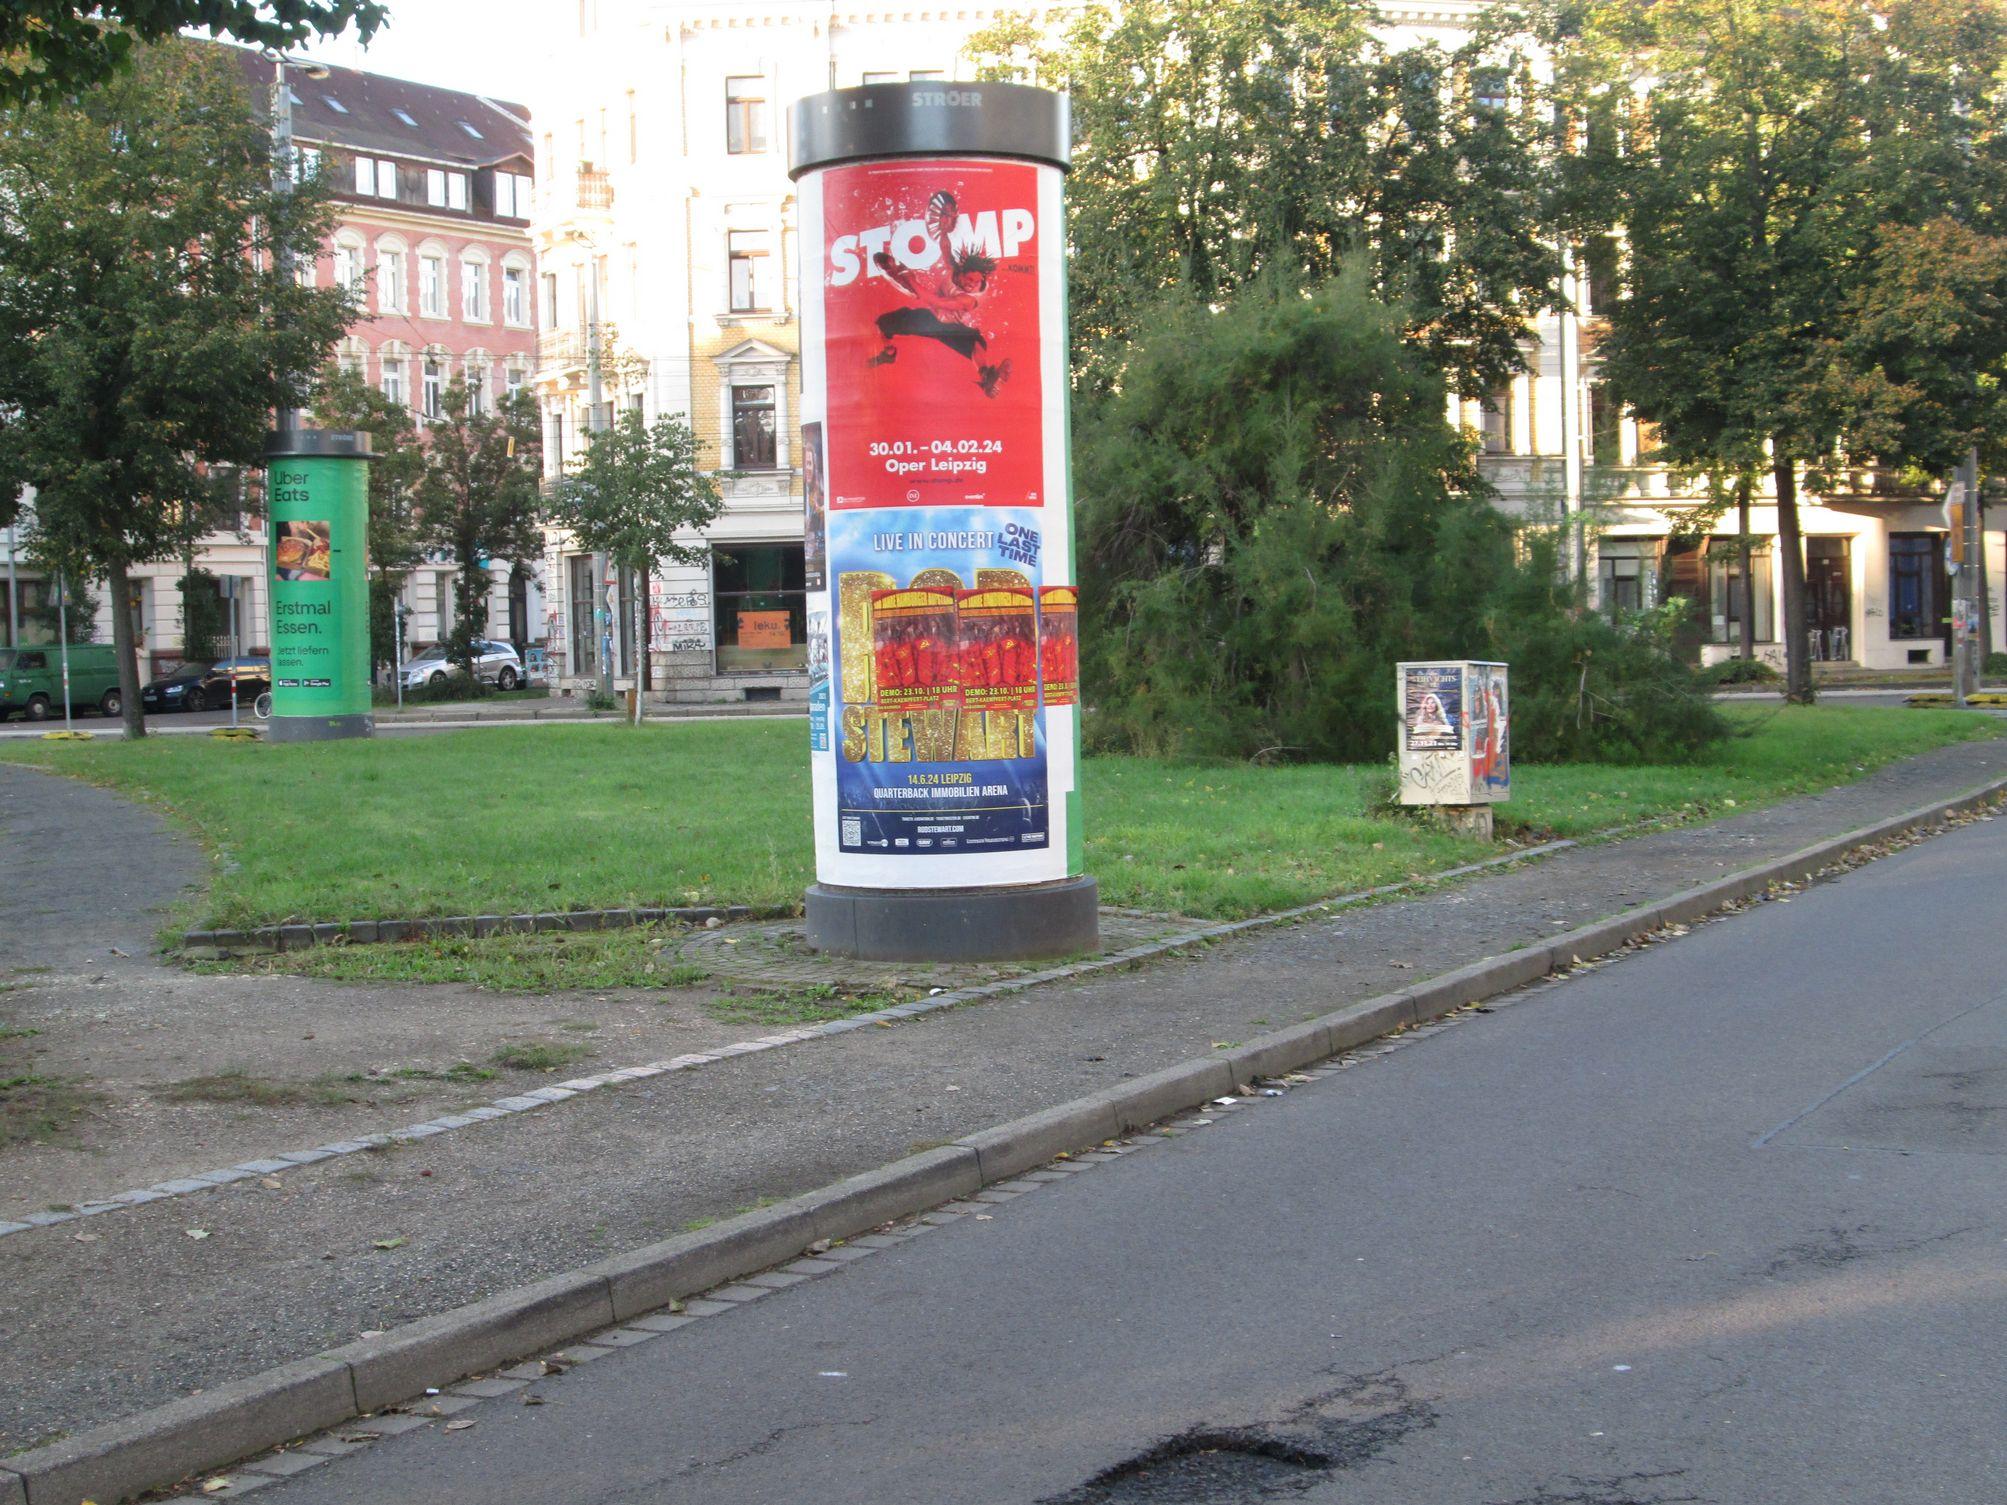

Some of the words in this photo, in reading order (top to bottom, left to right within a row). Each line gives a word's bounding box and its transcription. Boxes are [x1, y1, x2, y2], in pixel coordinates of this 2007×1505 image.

[912, 91, 983, 107] STRÖER
[829, 209, 1035, 287] STOMP
[885, 459, 926, 476] Oper
[931, 457, 987, 475] Leipzig
[274, 471, 309, 486] Uber
[274, 487, 310, 502] Eats
[1004, 522, 1039, 542] ONE
[873, 533, 903, 551] LIVE
[908, 532, 923, 550] IN
[928, 531, 994, 550] CONCERT
[997, 533, 1040, 554] LAST
[998, 545, 1037, 568] TIME
[276, 600, 331, 615] Erstmal
[276, 620, 323, 634] Essen.
[277, 647, 296, 656] Jetzt
[298, 646, 329, 656] liefern
[880, 689, 902, 697] DEMO:
[904, 688, 925, 696] 23.10.
[965, 688, 988, 696] DEMO:
[842, 706, 1035, 763] STEWART
[907, 774, 939, 785] 14.6.24
[941, 773, 972, 785] LEIPZIG
[873, 787, 930, 799] QUARTERBACK
[931, 786, 980, 798] IMMOBILIEN
[982, 785, 1008, 797] ARENA
